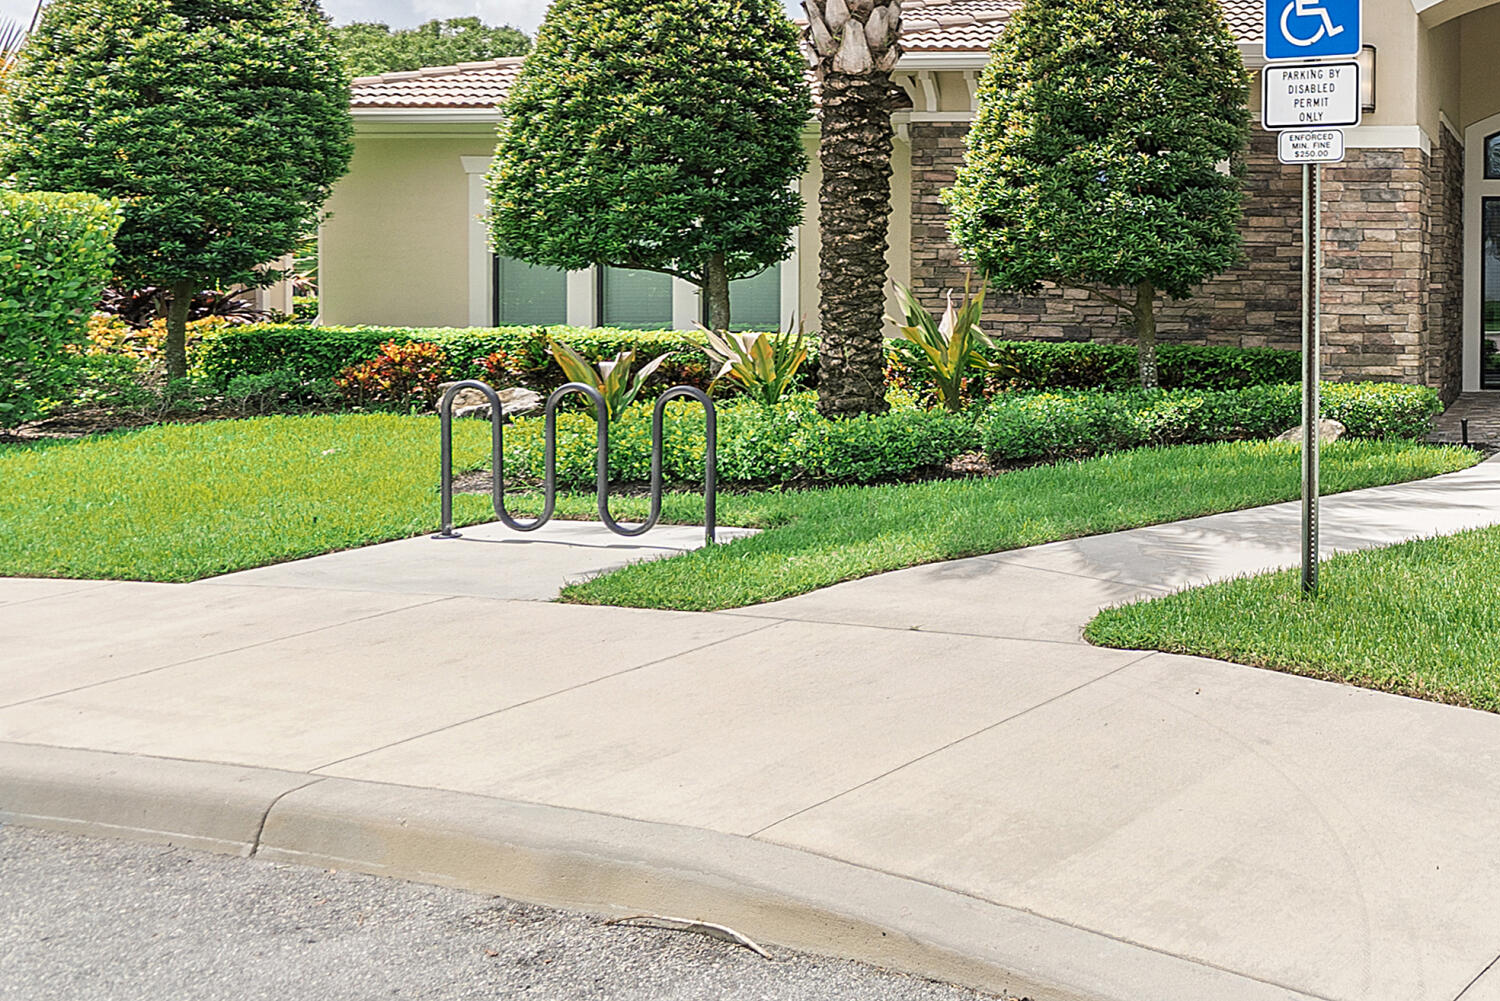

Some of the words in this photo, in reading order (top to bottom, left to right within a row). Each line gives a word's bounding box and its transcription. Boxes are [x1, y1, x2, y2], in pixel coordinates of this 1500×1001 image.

[1282, 69, 1323, 80] PARKING
[1329, 69, 1340, 78] BY
[1288, 83, 1335, 94] DISABLED
[1294, 97, 1328, 108] PERMIT
[1299, 112, 1323, 122] ONLY
[1289, 133, 1334, 141] ENFORCED
